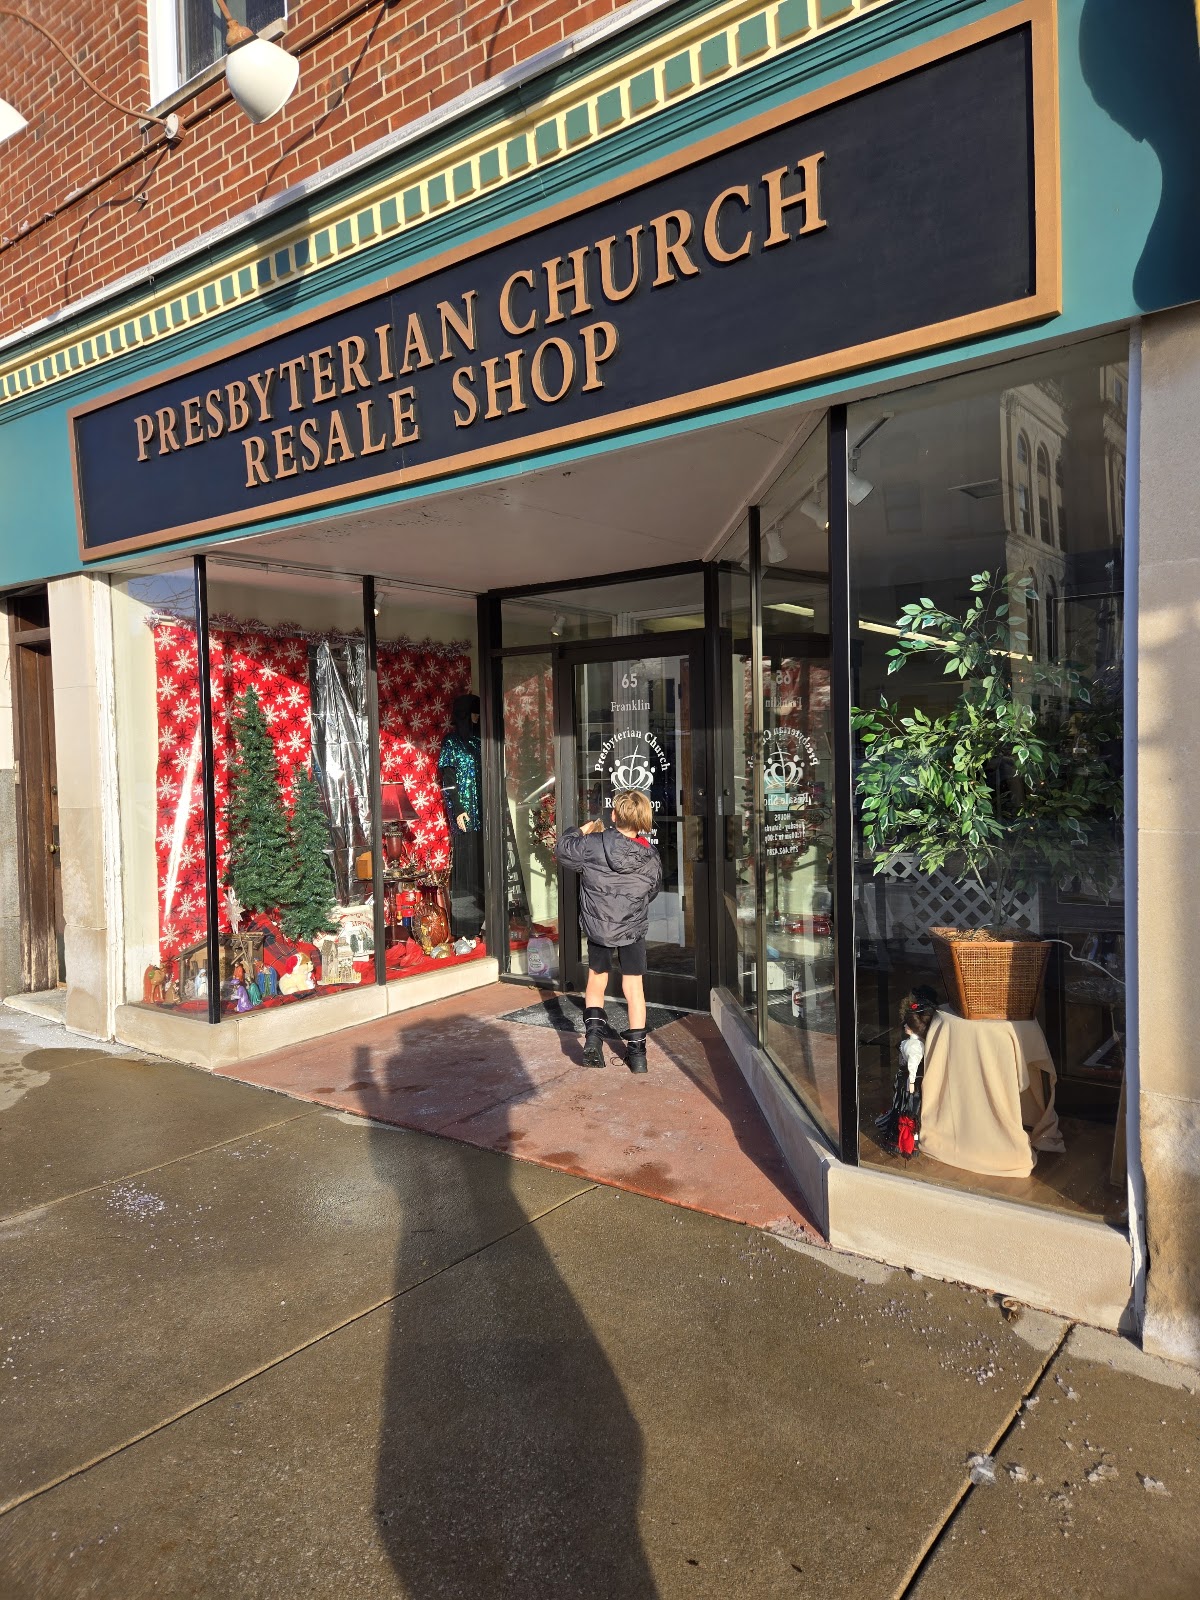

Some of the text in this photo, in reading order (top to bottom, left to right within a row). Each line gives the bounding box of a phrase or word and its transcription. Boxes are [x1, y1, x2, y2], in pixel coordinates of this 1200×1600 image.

[134, 151, 828, 462] PRESBYTERIAN CHURCH
[242, 321, 620, 489] RESALE SHOP
[621, 673, 638, 688] 65
[610, 699, 650, 712] Franklin
[595, 727, 670, 771] Presbyterian Church
